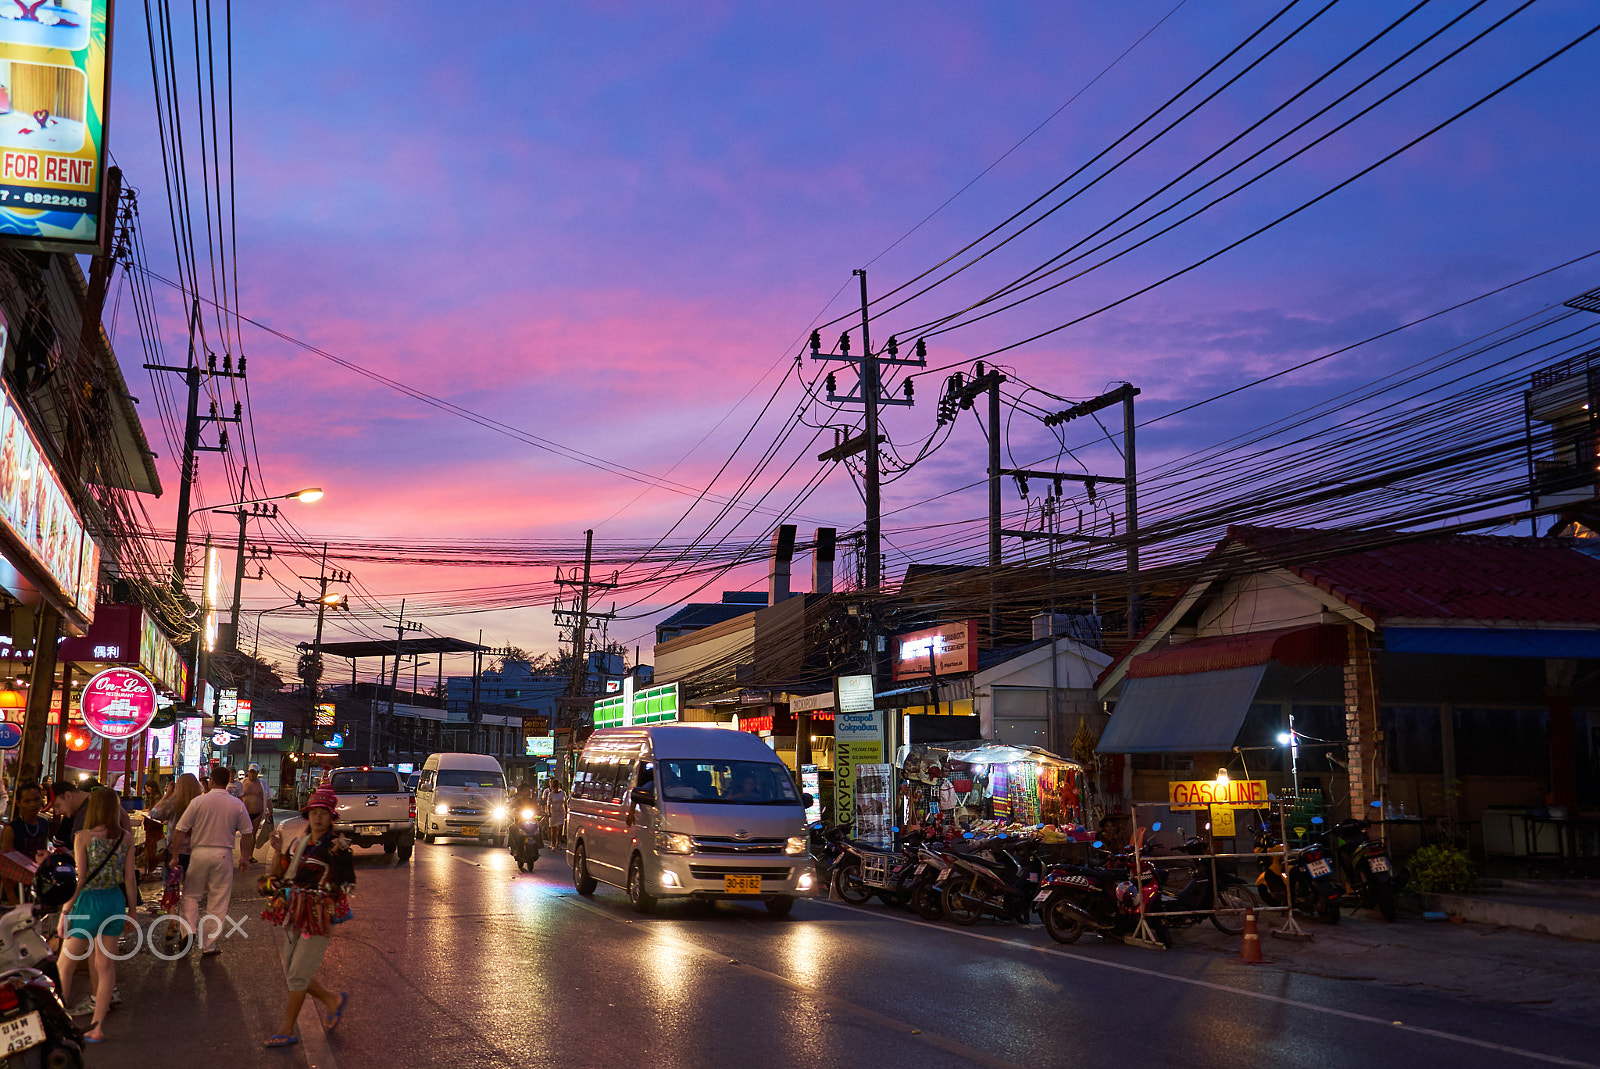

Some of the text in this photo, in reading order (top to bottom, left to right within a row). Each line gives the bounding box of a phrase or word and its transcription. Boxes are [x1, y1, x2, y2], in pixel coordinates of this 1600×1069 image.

[4, 153, 94, 185] FOR RENT
[24, 192, 87, 207] 8922248
[93, 645, 120, 658] 偶利
[95, 677, 148, 693] On-Lee
[843, 714, 873, 724] Остров
[838, 723, 878, 733] Сокровищ
[838, 743, 851, 824] СКУРСИИ
[1174, 782, 1262, 807] GASOLINE
[726, 878, 760, 889] 30-6182
